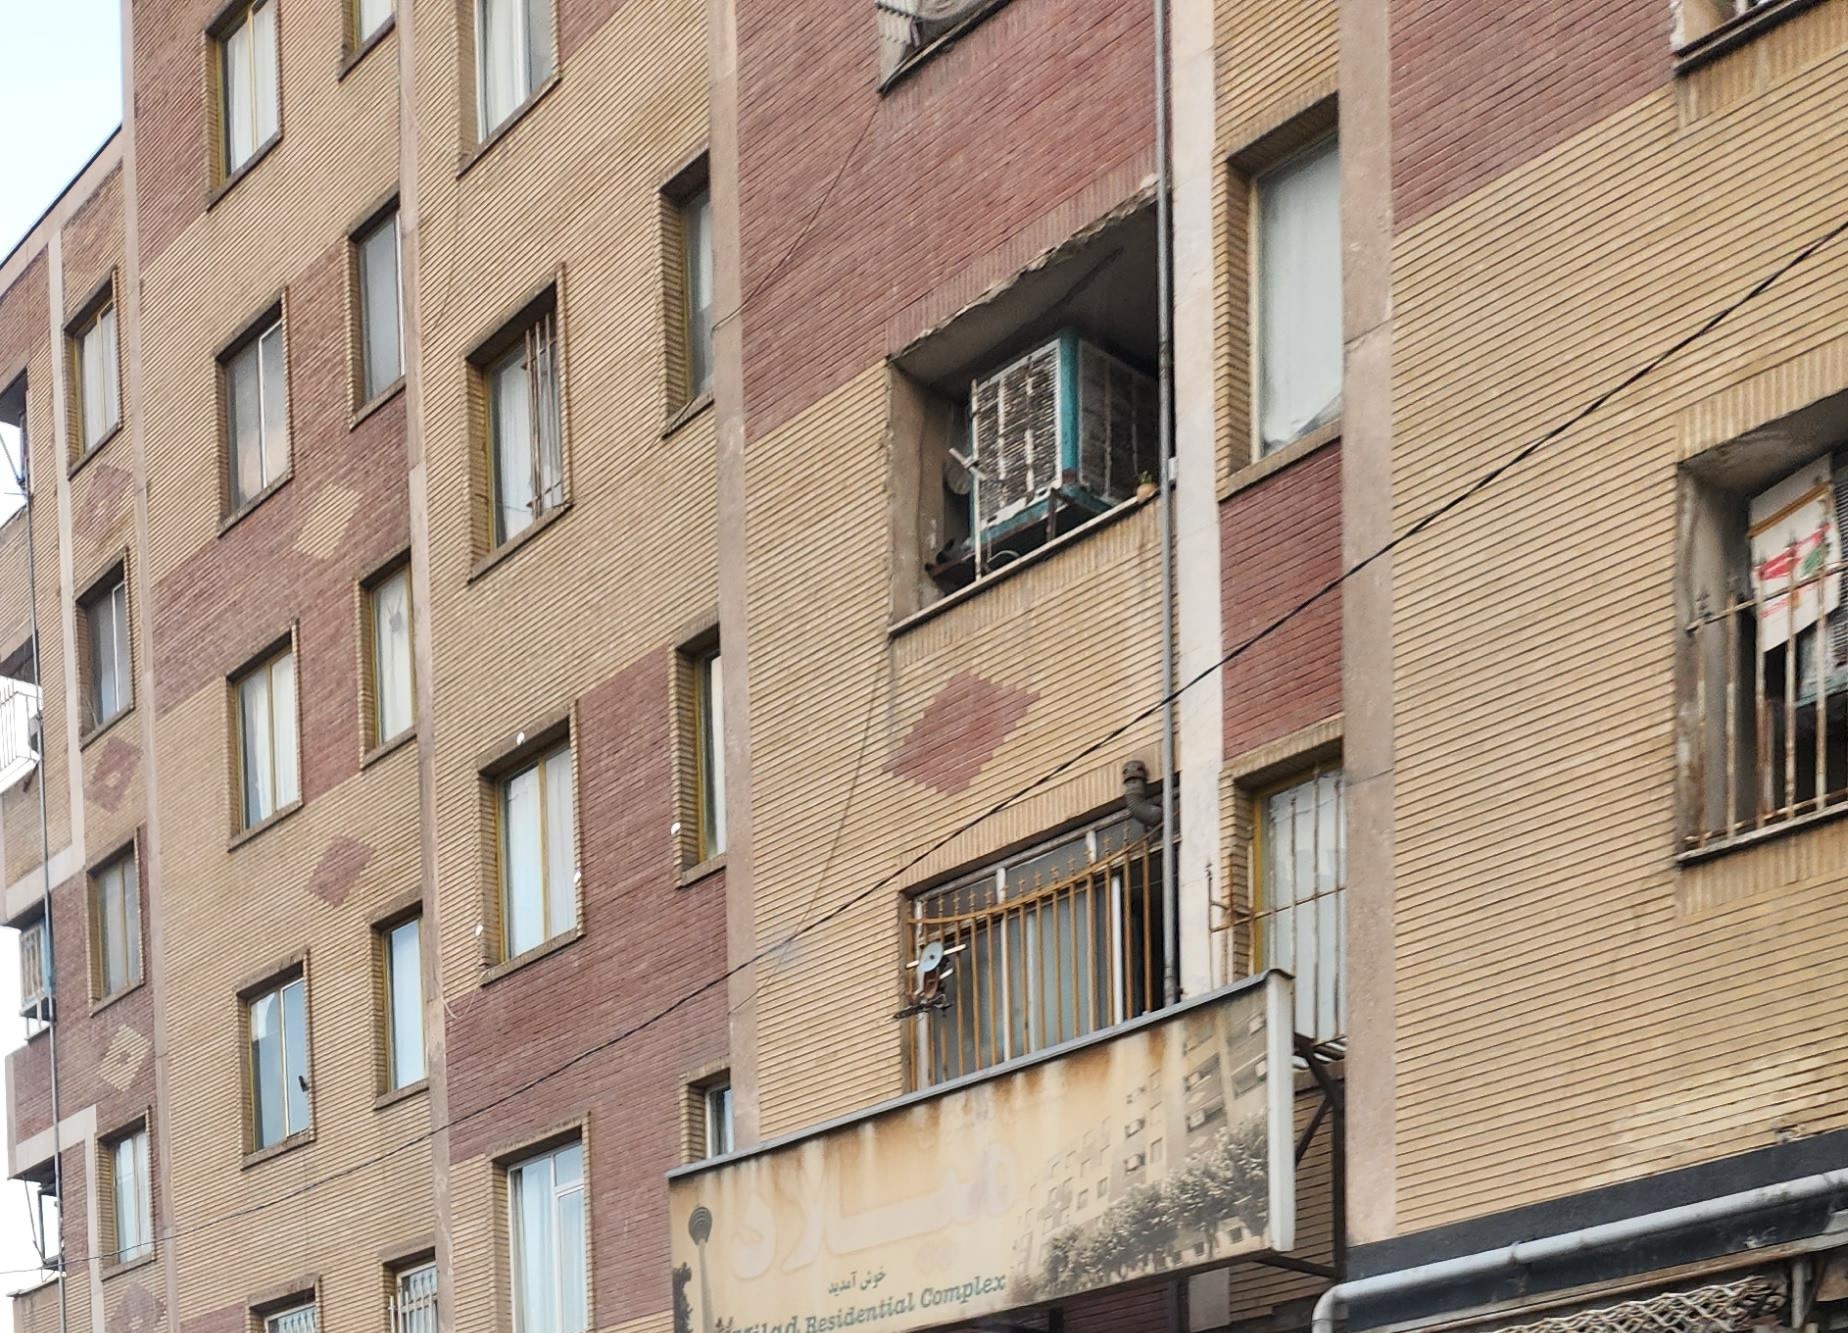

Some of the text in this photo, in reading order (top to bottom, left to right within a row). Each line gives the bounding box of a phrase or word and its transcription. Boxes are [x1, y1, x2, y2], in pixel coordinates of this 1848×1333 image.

[828, 1265, 887, 1296] خوش آمدید
[920, 1274, 1006, 1309] Complex
